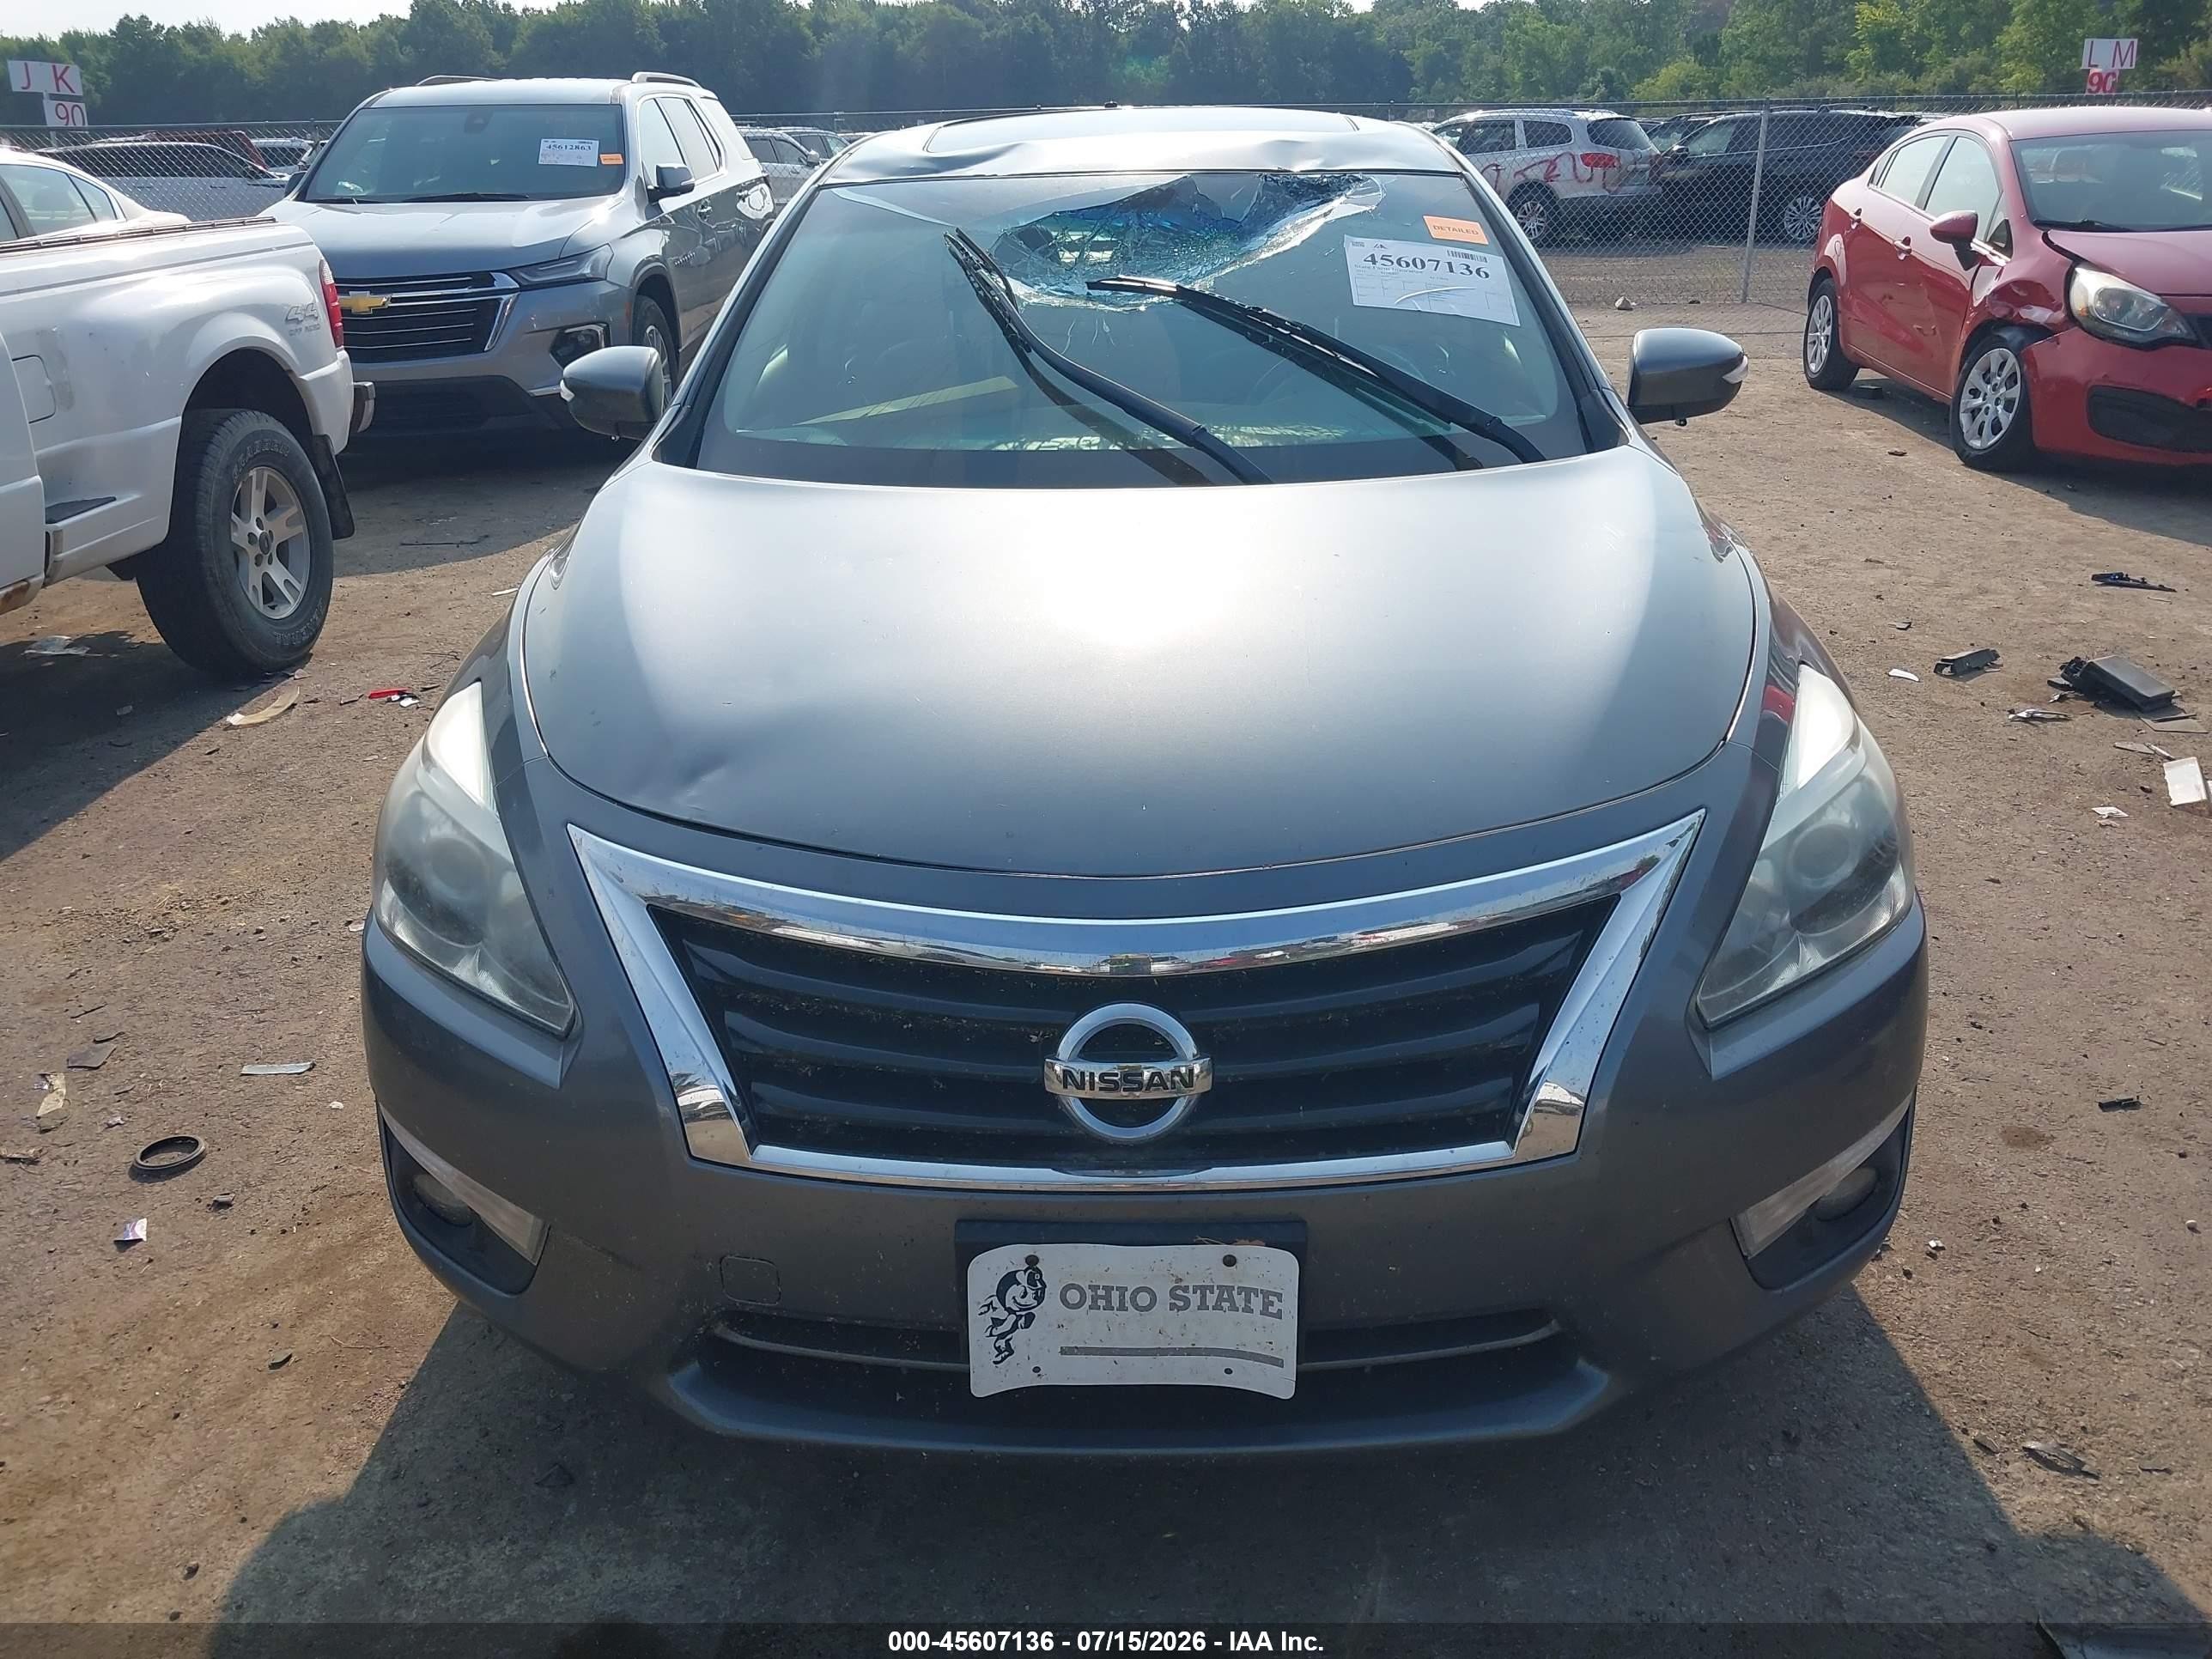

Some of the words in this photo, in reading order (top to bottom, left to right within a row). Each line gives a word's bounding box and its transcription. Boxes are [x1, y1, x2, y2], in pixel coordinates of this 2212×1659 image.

[2088, 40, 2099, 67] L
[2112, 40, 2135, 67] M
[21, 62, 31, 89] J
[52, 64, 76, 94] K
[55, 102, 86, 126] 90
[1432, 225, 1479, 235] DETAILED
[1364, 253, 1490, 279] 45607136
[1062, 1068, 1194, 1093] NISSAN
[1059, 1282, 1158, 1313] OHIO
[1168, 1285, 1283, 1320] STATE
